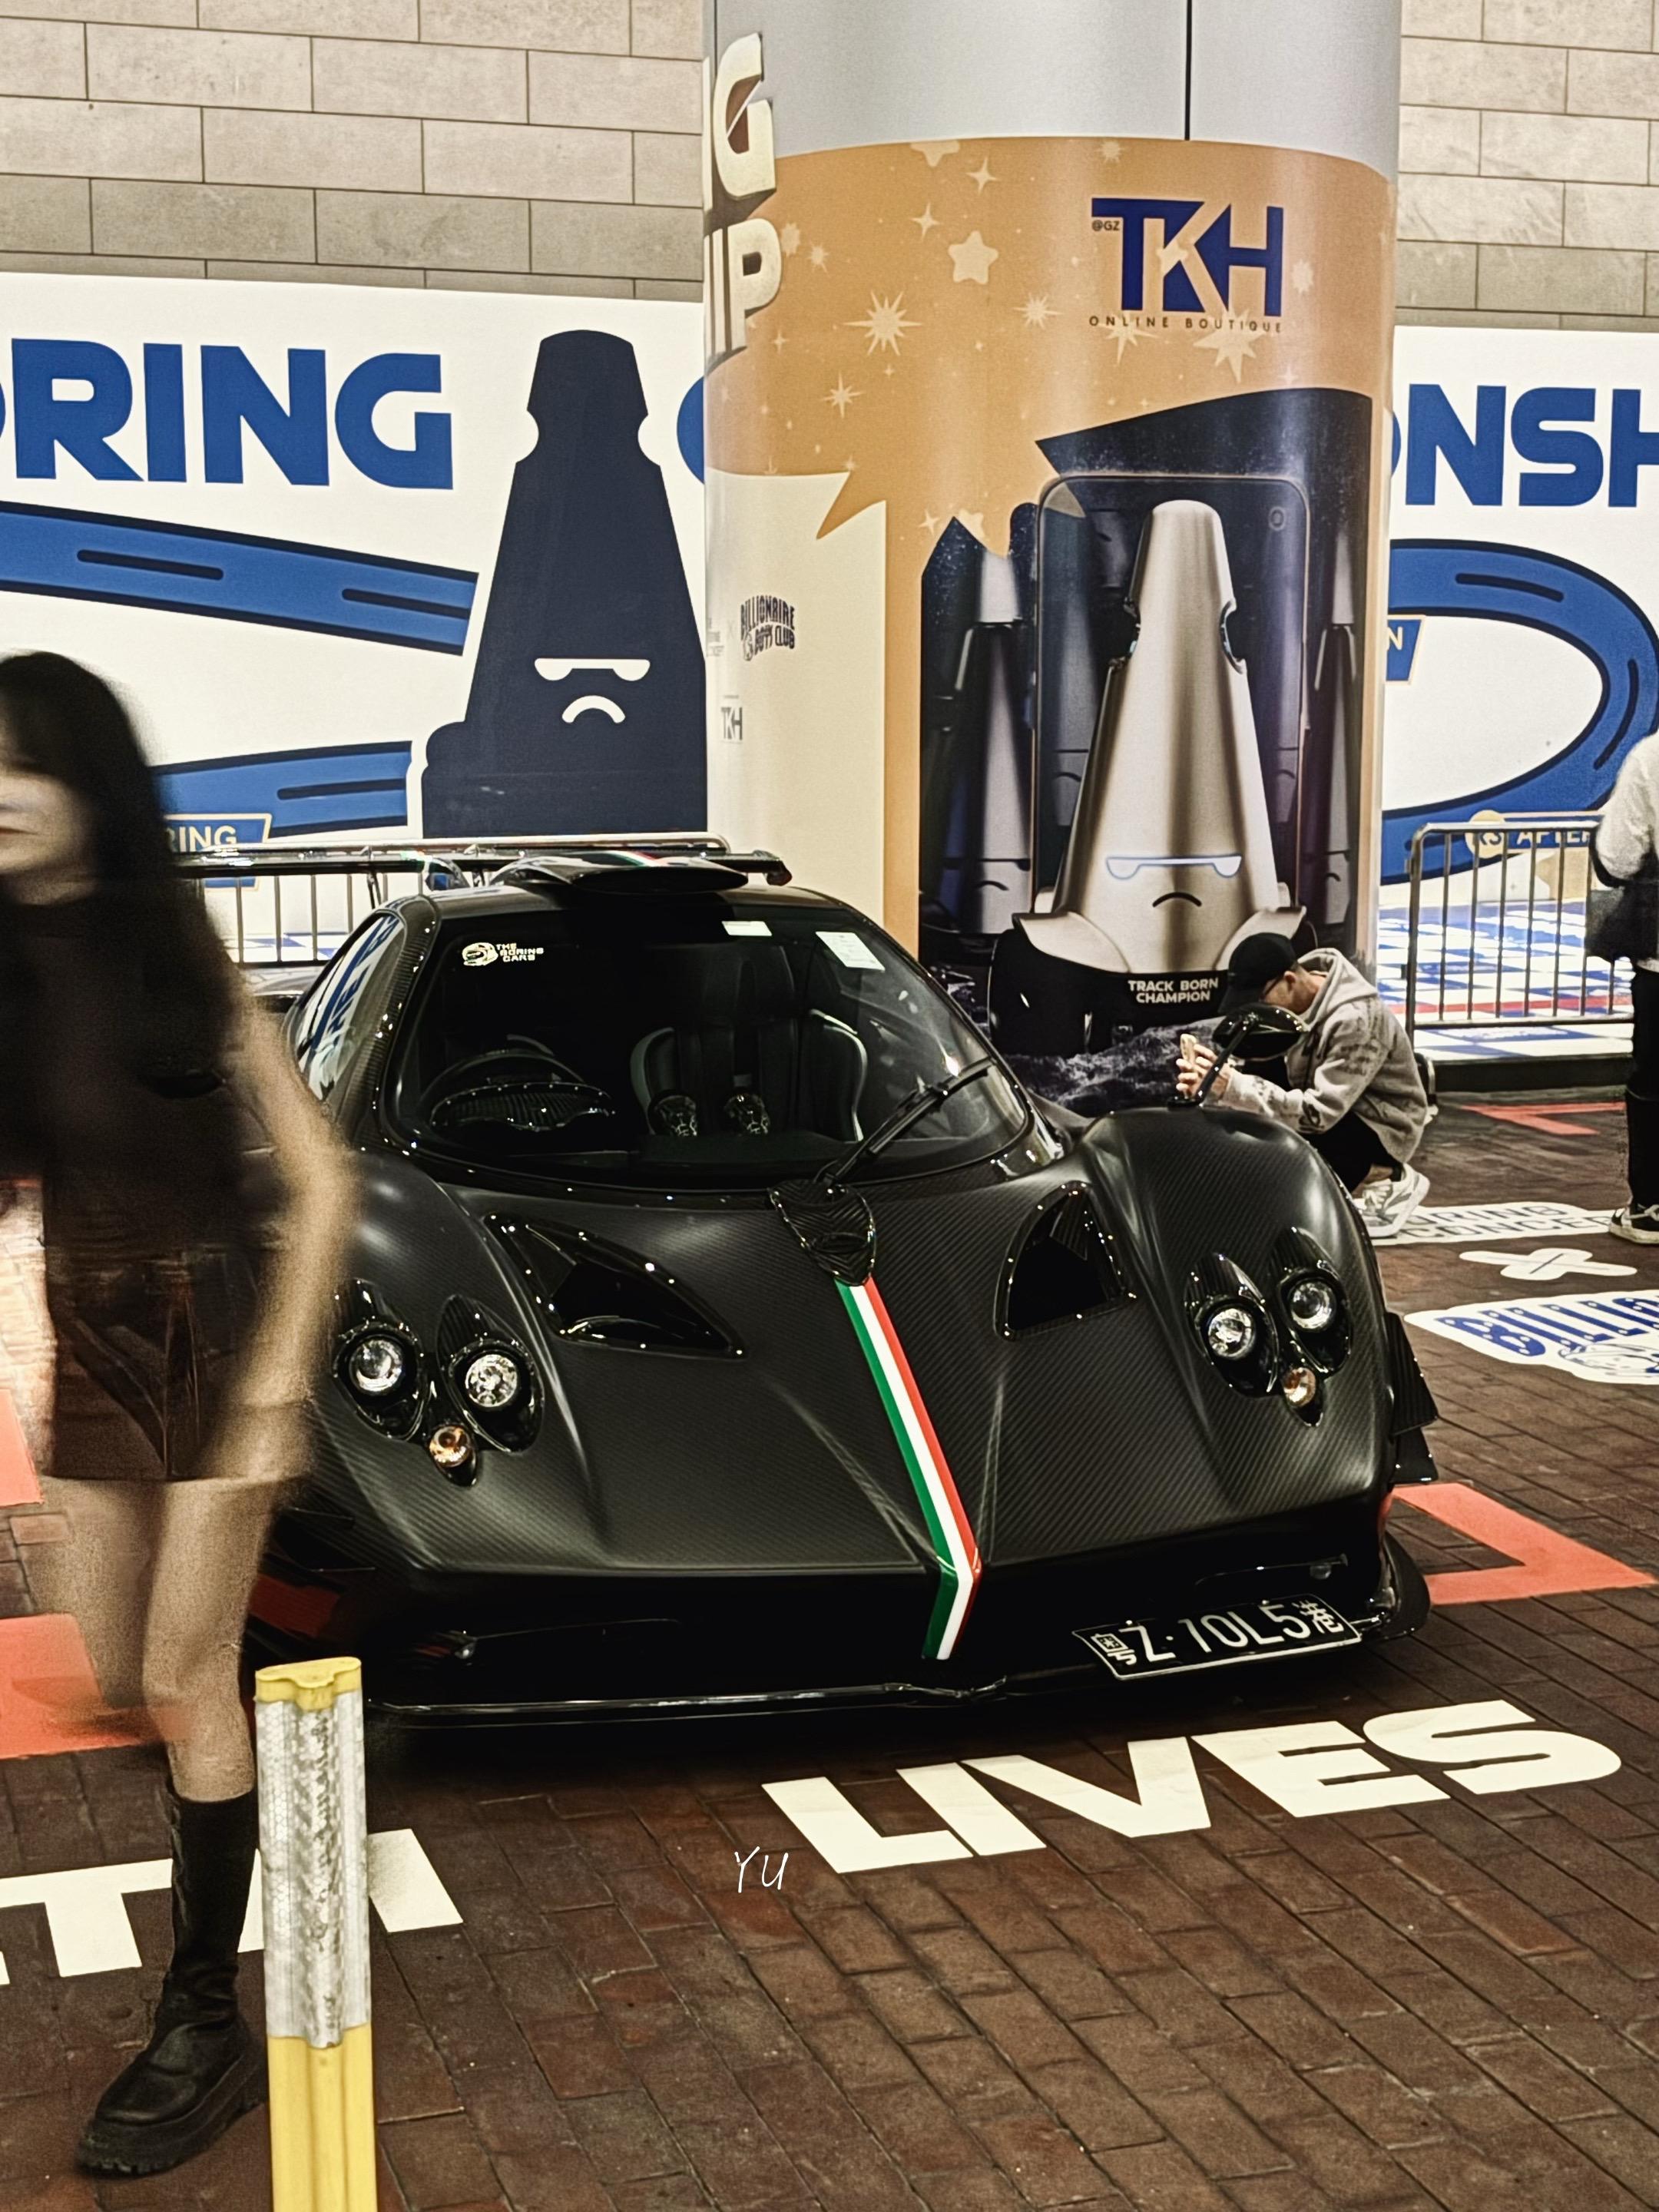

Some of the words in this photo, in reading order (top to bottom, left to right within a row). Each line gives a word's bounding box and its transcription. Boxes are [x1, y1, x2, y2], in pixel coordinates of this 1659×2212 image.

[1091, 220, 1120, 231] @GZ
[1091, 197, 1283, 316] TKH
[1089, 315, 1169, 328] ONLINE
[1184, 317, 1282, 333] BOUTIQUE
[0, 338, 453, 490] RING
[740, 595, 795, 640] BILLIONAIRE
[1128, 980, 1174, 992] TRACK
[1181, 978, 1219, 991] BORN
[1136, 991, 1210, 1004] CHAMPION
[761, 1700, 1622, 1873] LIVES
